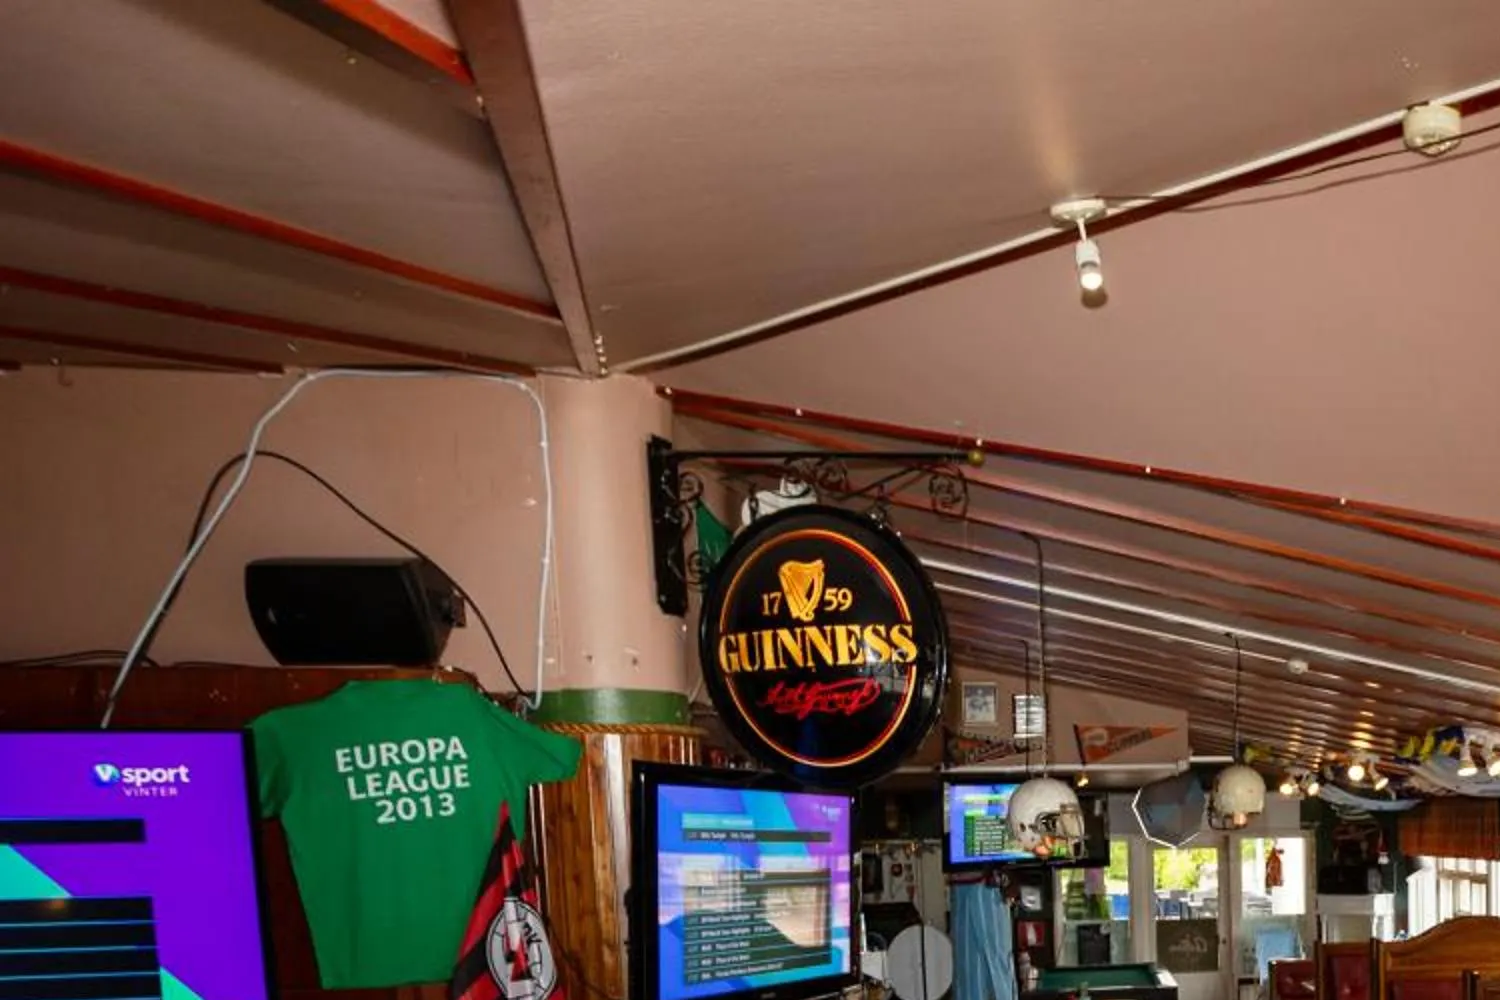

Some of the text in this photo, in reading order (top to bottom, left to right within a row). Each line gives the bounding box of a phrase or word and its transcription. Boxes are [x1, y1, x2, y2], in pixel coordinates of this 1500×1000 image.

[761, 588, 852, 616] 17 59
[719, 624, 918, 673] GUINNESS
[335, 736, 468, 773] EUROPA
[121, 764, 191, 787] sport
[122, 786, 178, 797] VINTER
[347, 764, 470, 801] LEAGUE
[375, 792, 456, 824] 2013
